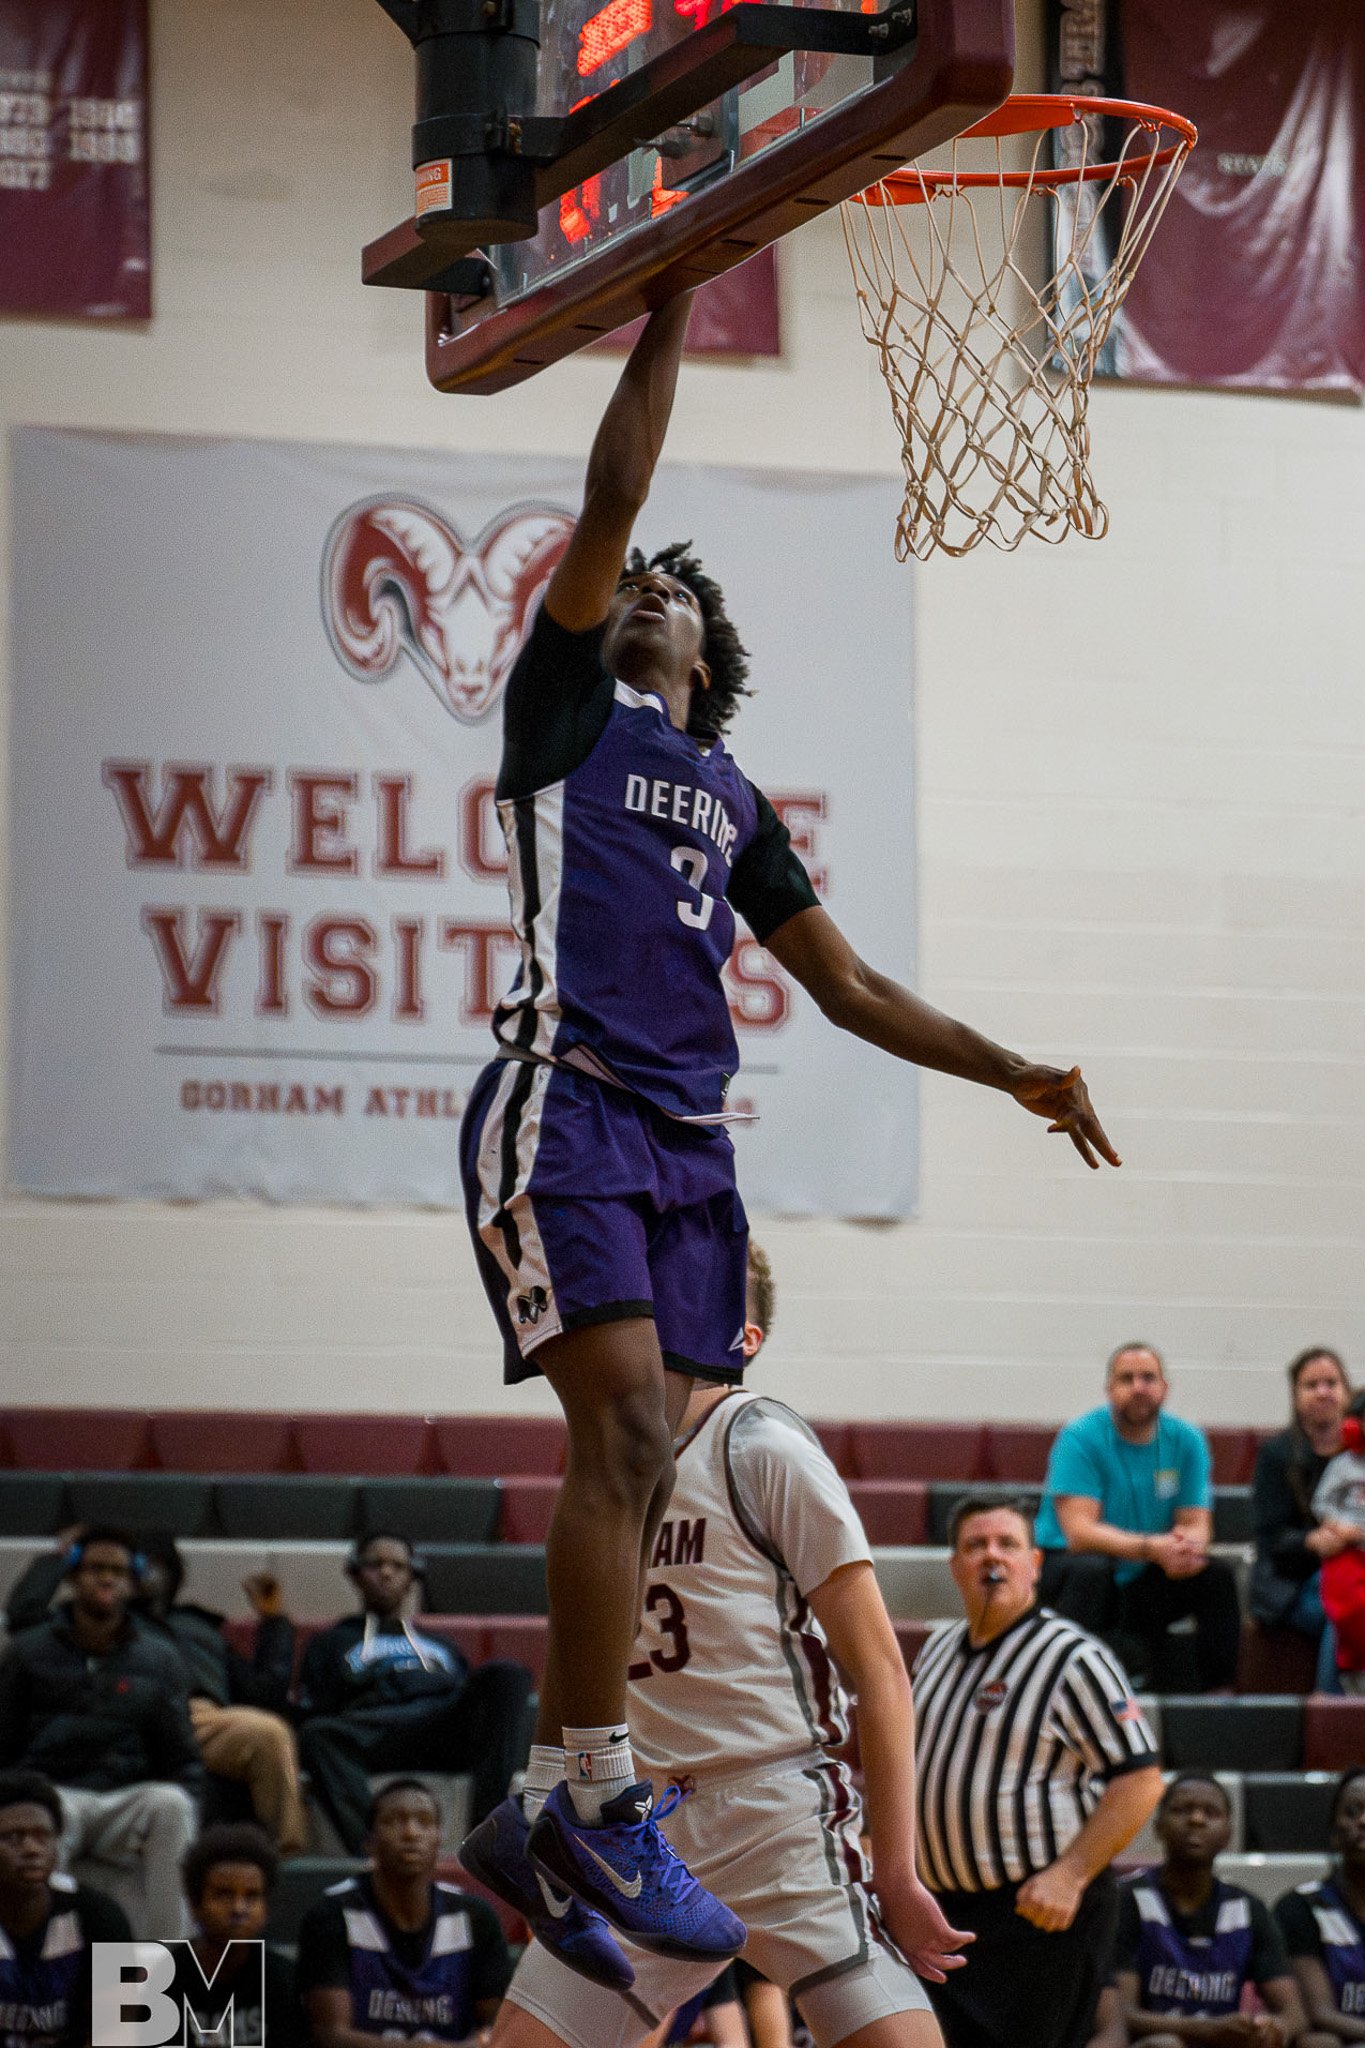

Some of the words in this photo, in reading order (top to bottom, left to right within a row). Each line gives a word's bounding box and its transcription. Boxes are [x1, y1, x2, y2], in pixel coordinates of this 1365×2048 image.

[102, 758, 828, 896] WELCE
[670, 845, 715, 931] 3
[138, 903, 793, 1037] VISITS
[180, 1081, 344, 1116] GORHAM
